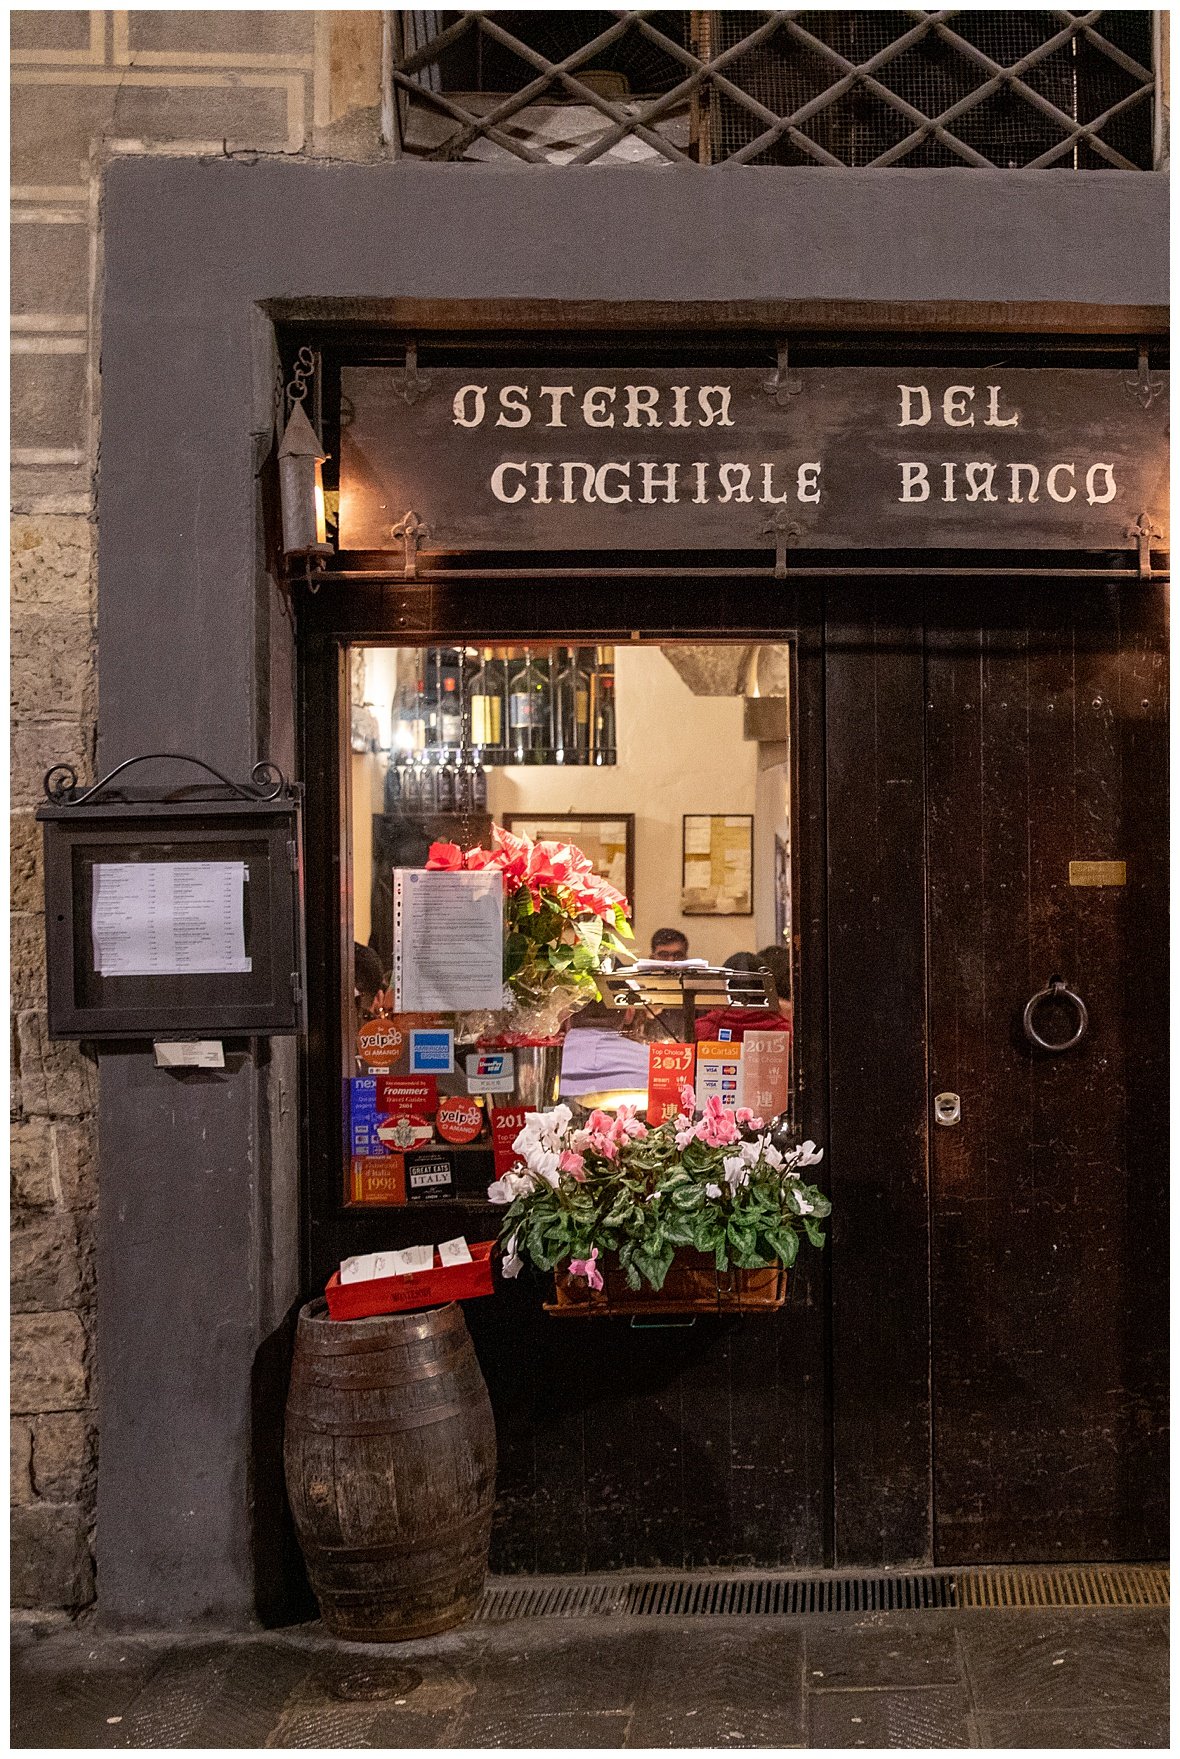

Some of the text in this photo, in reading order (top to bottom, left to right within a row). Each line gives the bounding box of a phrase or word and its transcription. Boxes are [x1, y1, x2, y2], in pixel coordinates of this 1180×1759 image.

[453, 384, 1019, 428] OSTERIA DEL
[490, 461, 1119, 505] CINGHIALE BIANCO
[361, 1033, 389, 1048] yelp
[747, 1040, 785, 1053] 2015
[652, 1048, 663, 1056] Top
[652, 1055, 692, 1070] 2017
[355, 1080, 377, 1089] nex
[440, 1109, 468, 1126] yelp
[496, 1115, 525, 1129] 201
[412, 1164, 449, 1175] GREAT EATS
[368, 1178, 397, 1191] 1998
[413, 1173, 448, 1185] ITALY
